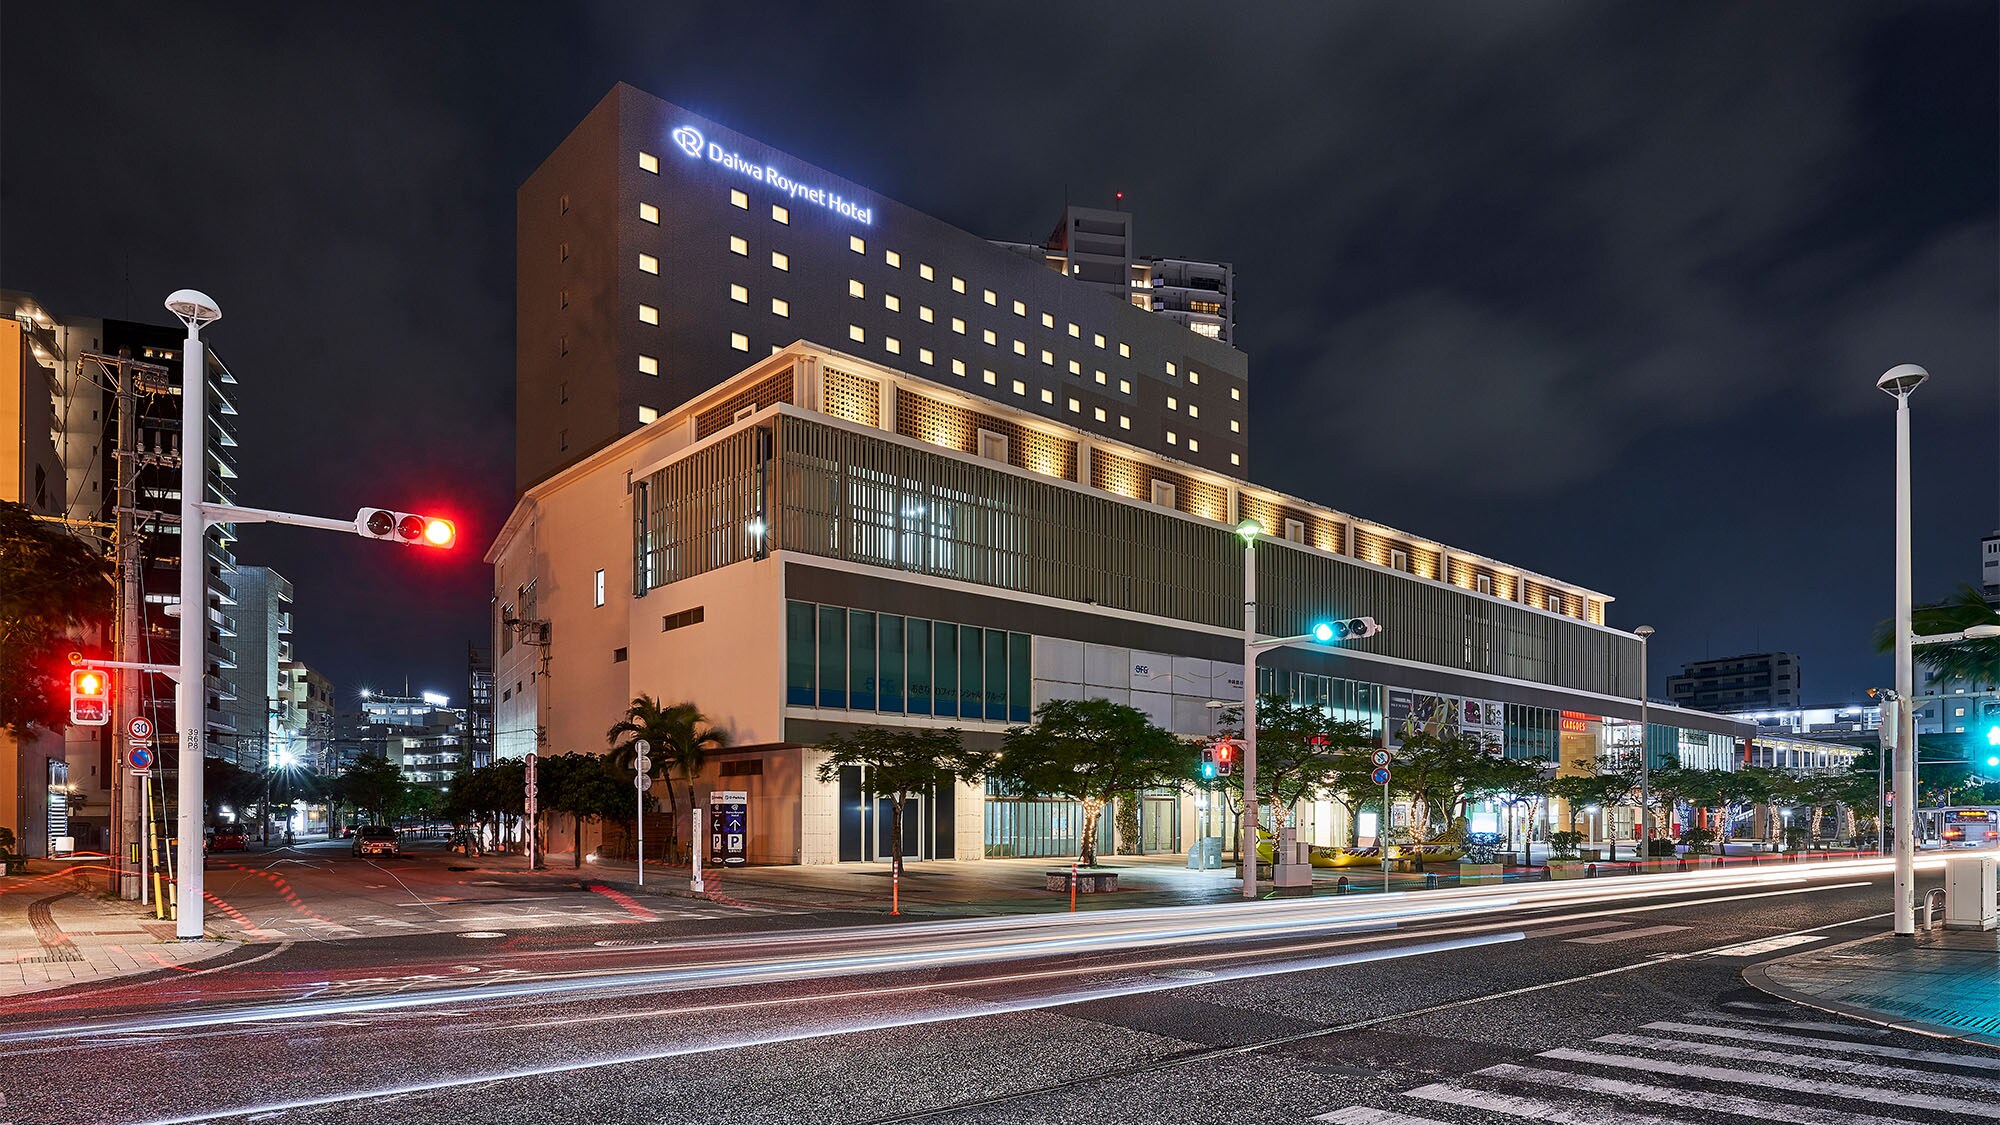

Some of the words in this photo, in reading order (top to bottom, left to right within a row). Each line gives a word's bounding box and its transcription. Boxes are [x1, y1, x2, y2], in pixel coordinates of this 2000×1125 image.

[709, 142, 763, 180] Daiwa
[766, 167, 826, 207] Roynet
[829, 193, 871, 225] Hotel
[133, 723, 148, 734] 30
[731, 836, 740, 848] P
